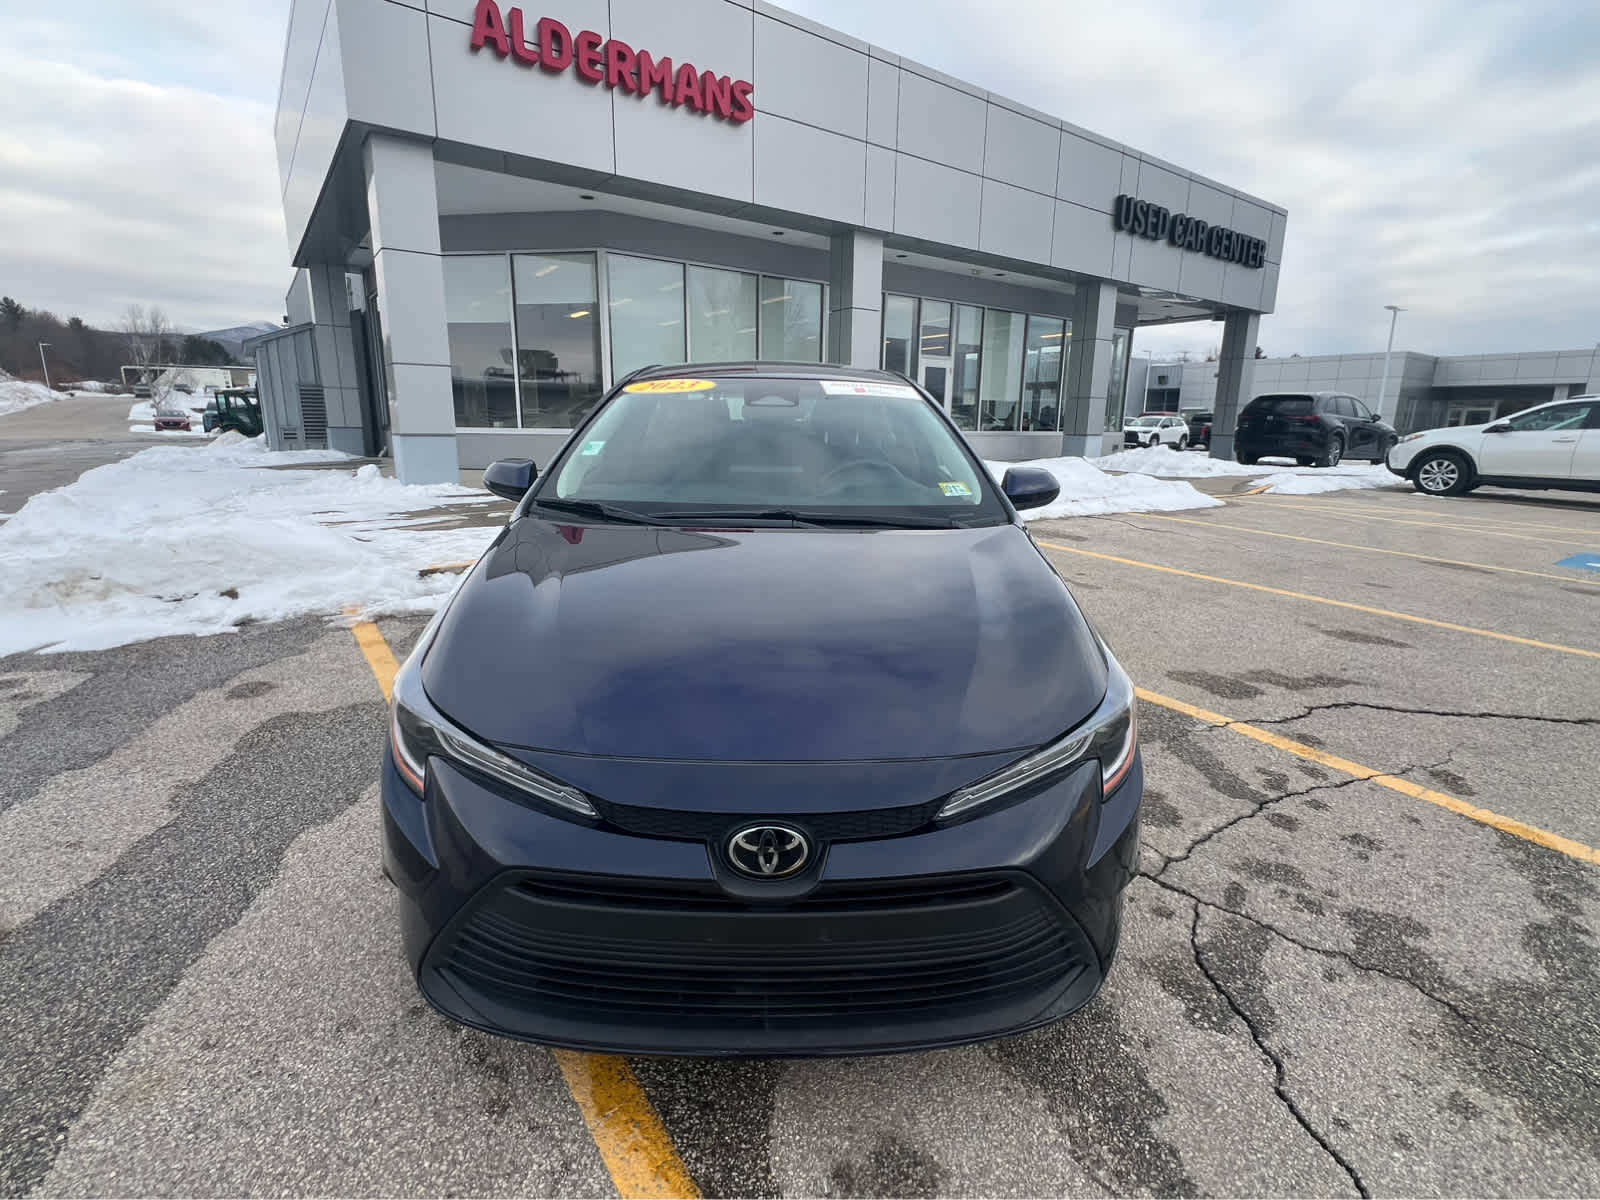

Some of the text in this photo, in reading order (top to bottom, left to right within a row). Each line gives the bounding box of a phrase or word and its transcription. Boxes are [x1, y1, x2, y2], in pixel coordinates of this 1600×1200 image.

[471, 0, 754, 122] ALDERMANS
[1115, 194, 1267, 269] USED CAR CENTER
